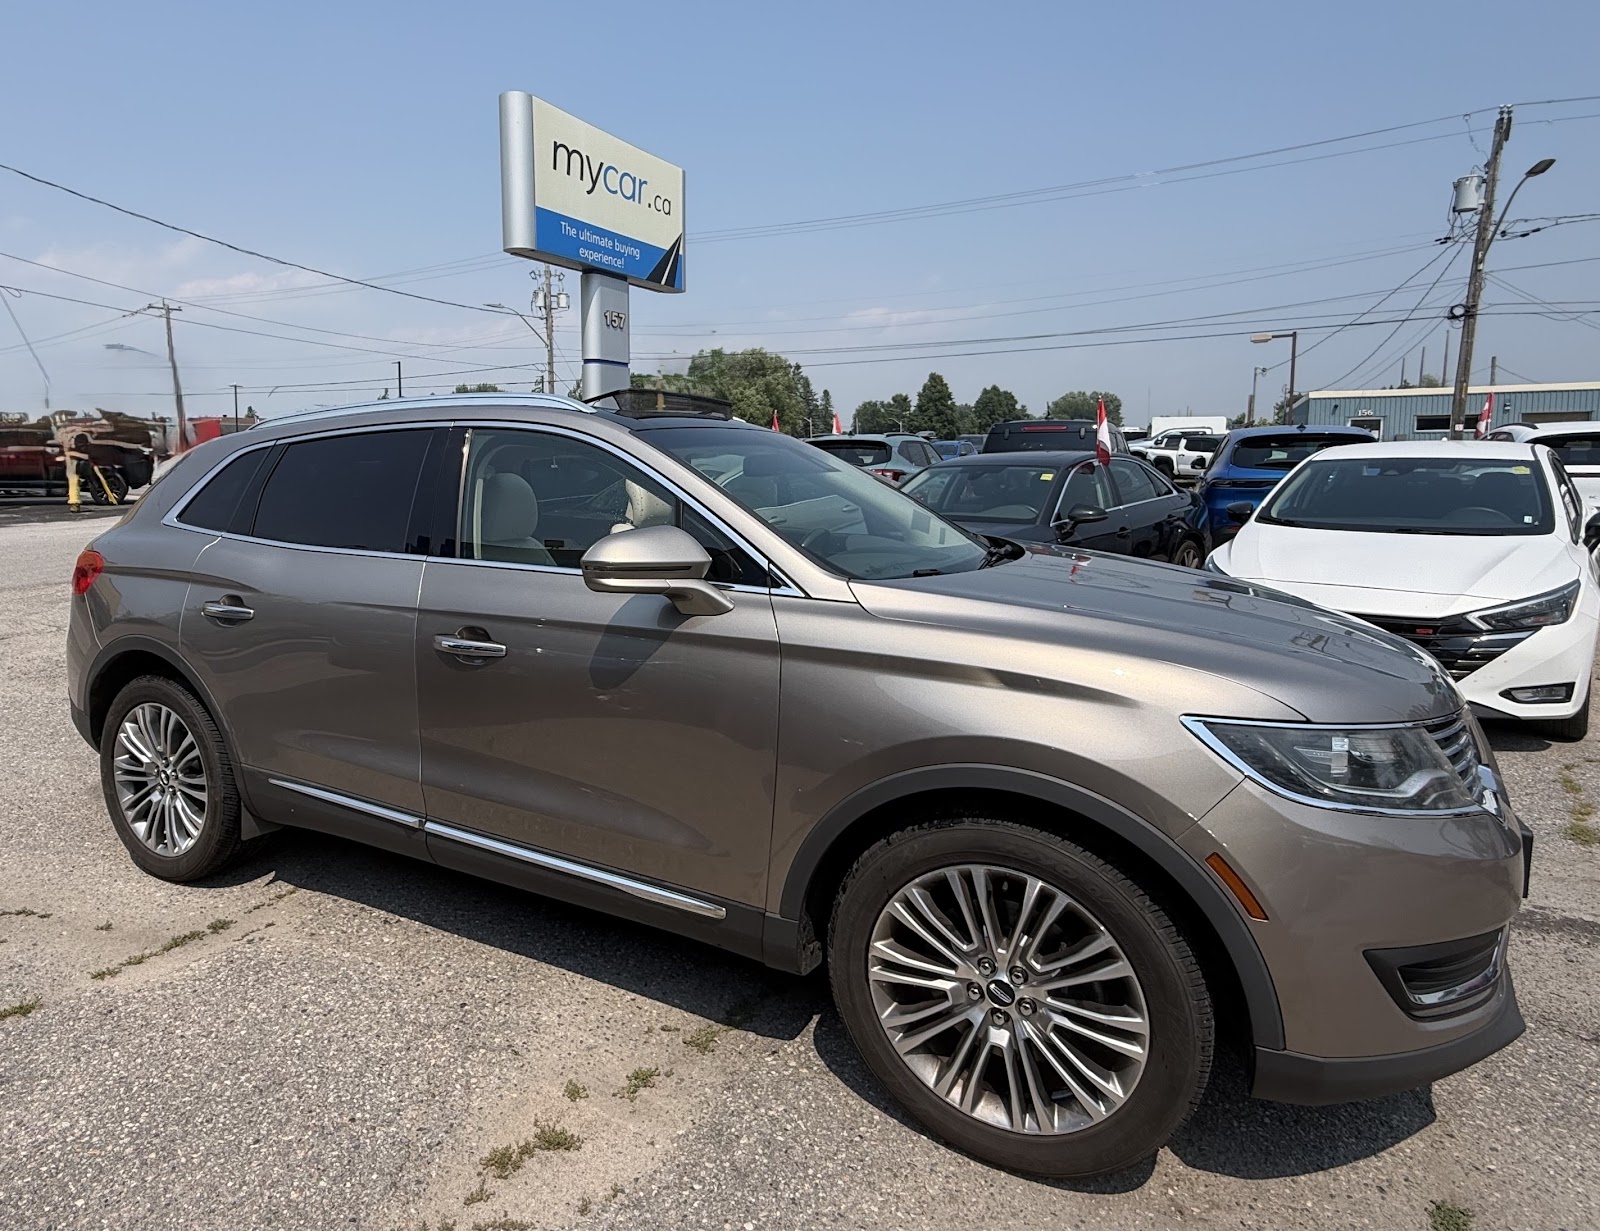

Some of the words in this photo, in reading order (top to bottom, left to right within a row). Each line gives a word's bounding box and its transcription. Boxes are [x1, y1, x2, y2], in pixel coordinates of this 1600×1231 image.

[552, 140, 672, 216] mycar.ca
[560, 221, 577, 238] The
[578, 228, 613, 249] ultimate
[614, 238, 640, 260] buying
[579, 247, 625, 269] experience!
[604, 309, 626, 330] 157
[1358, 409, 1374, 417] 156
